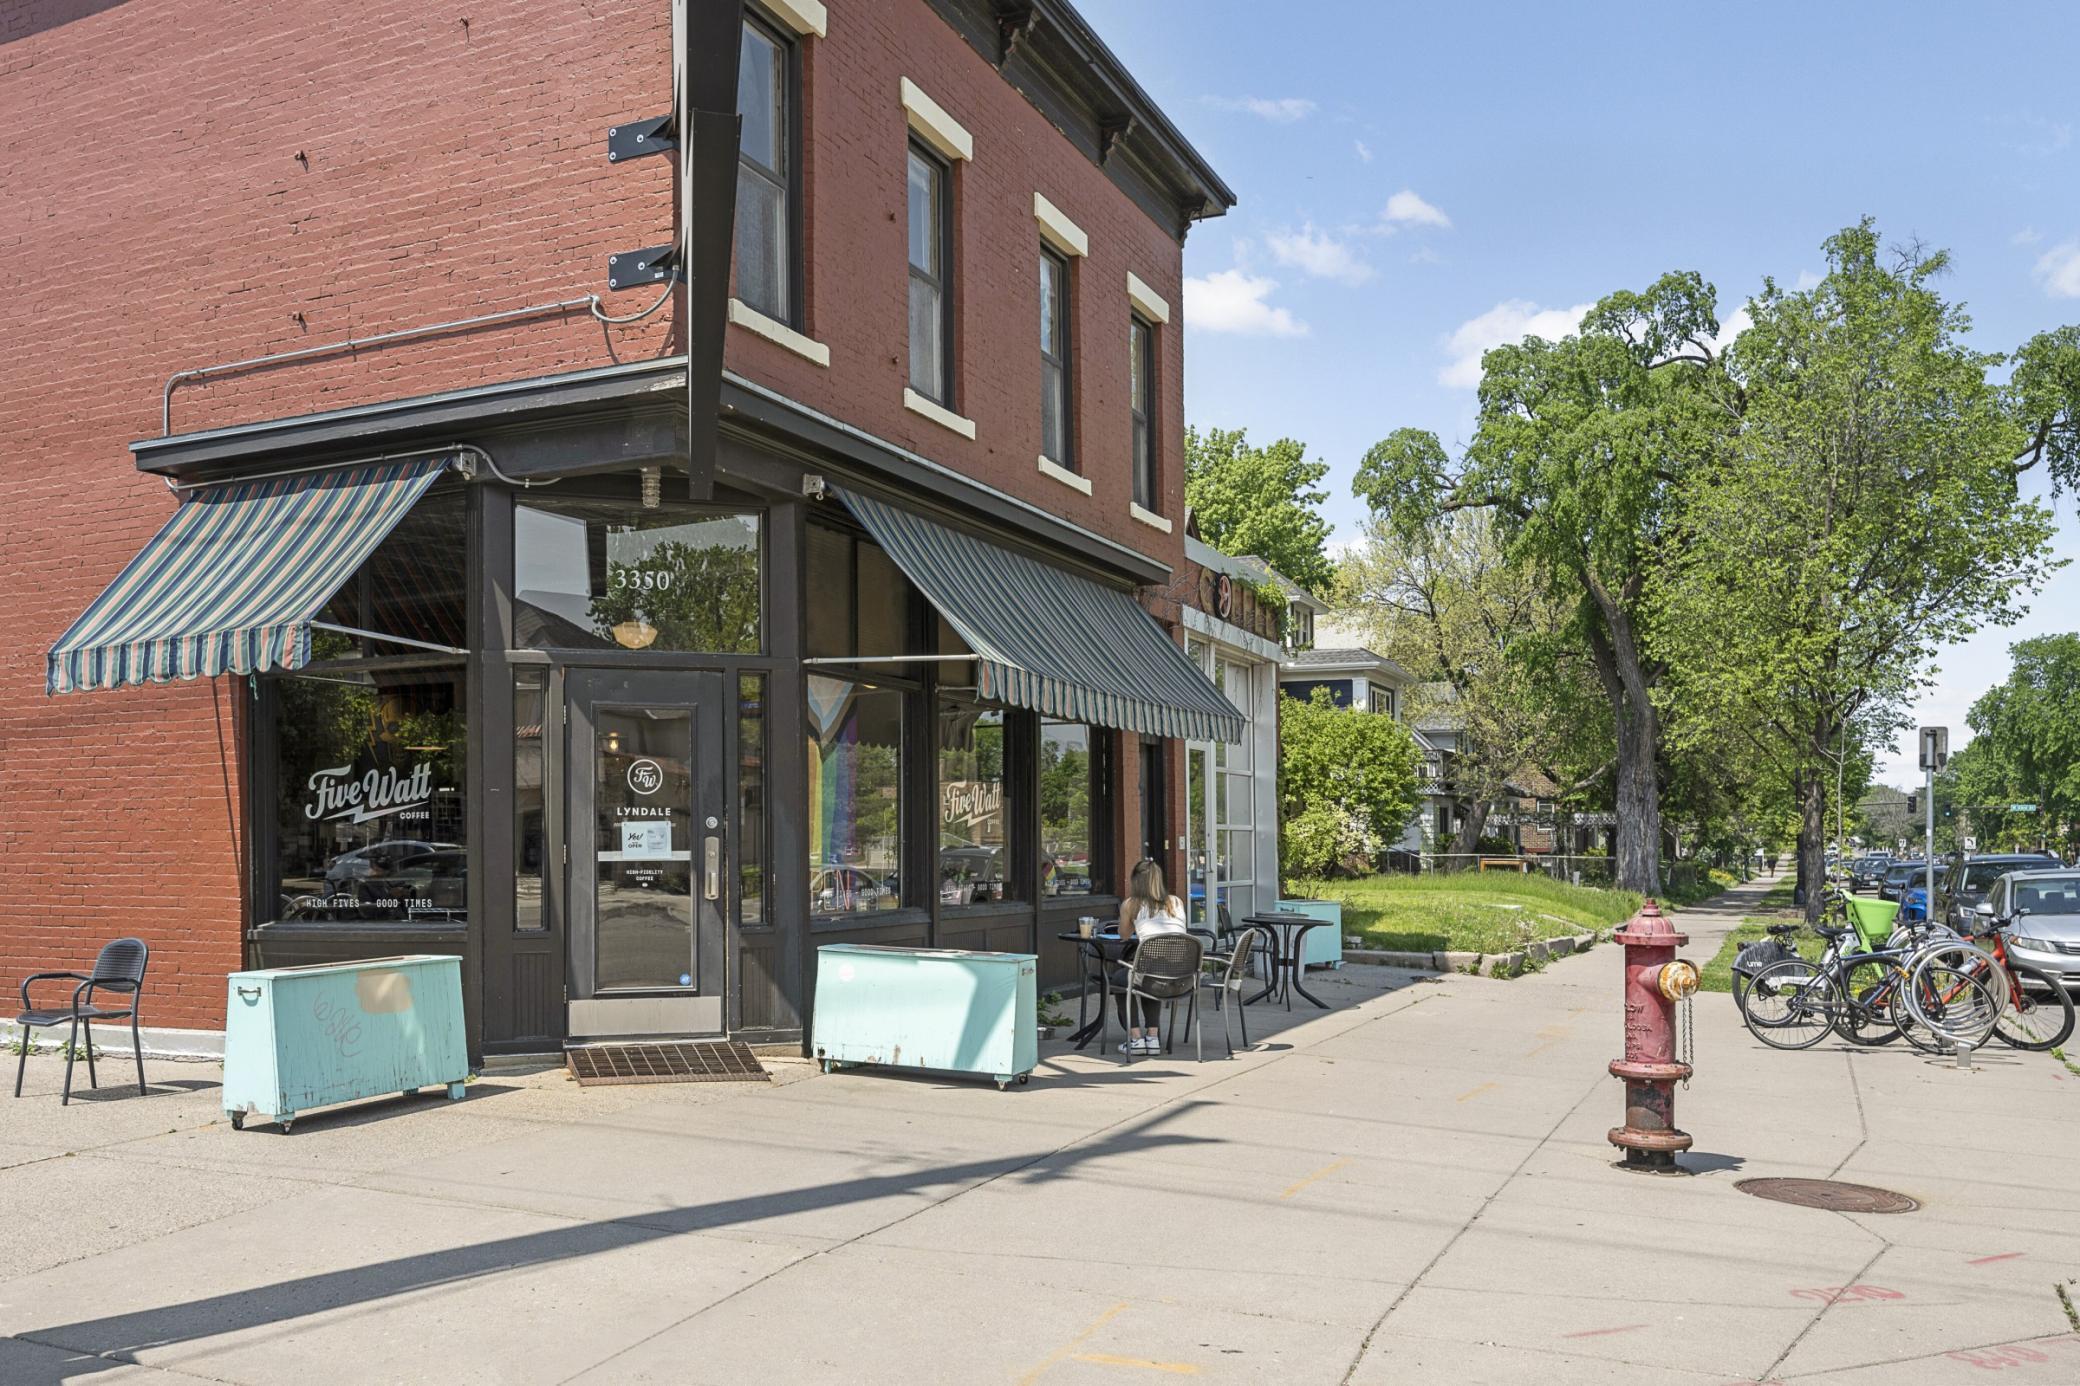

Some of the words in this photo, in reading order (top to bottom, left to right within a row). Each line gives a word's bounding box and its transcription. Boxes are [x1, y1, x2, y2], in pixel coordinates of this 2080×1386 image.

[614, 569, 670, 590] 3350
[305, 764, 362, 819] Five
[363, 762, 432, 808] Watt
[945, 780, 971, 822] Five
[972, 782, 1000, 815] Watt
[616, 807, 672, 816] LYNDALE
[306, 899, 328, 908] HIGH
[333, 899, 360, 908] FIVES
[376, 899, 398, 908] GOOD
[404, 899, 433, 908] TIMES
